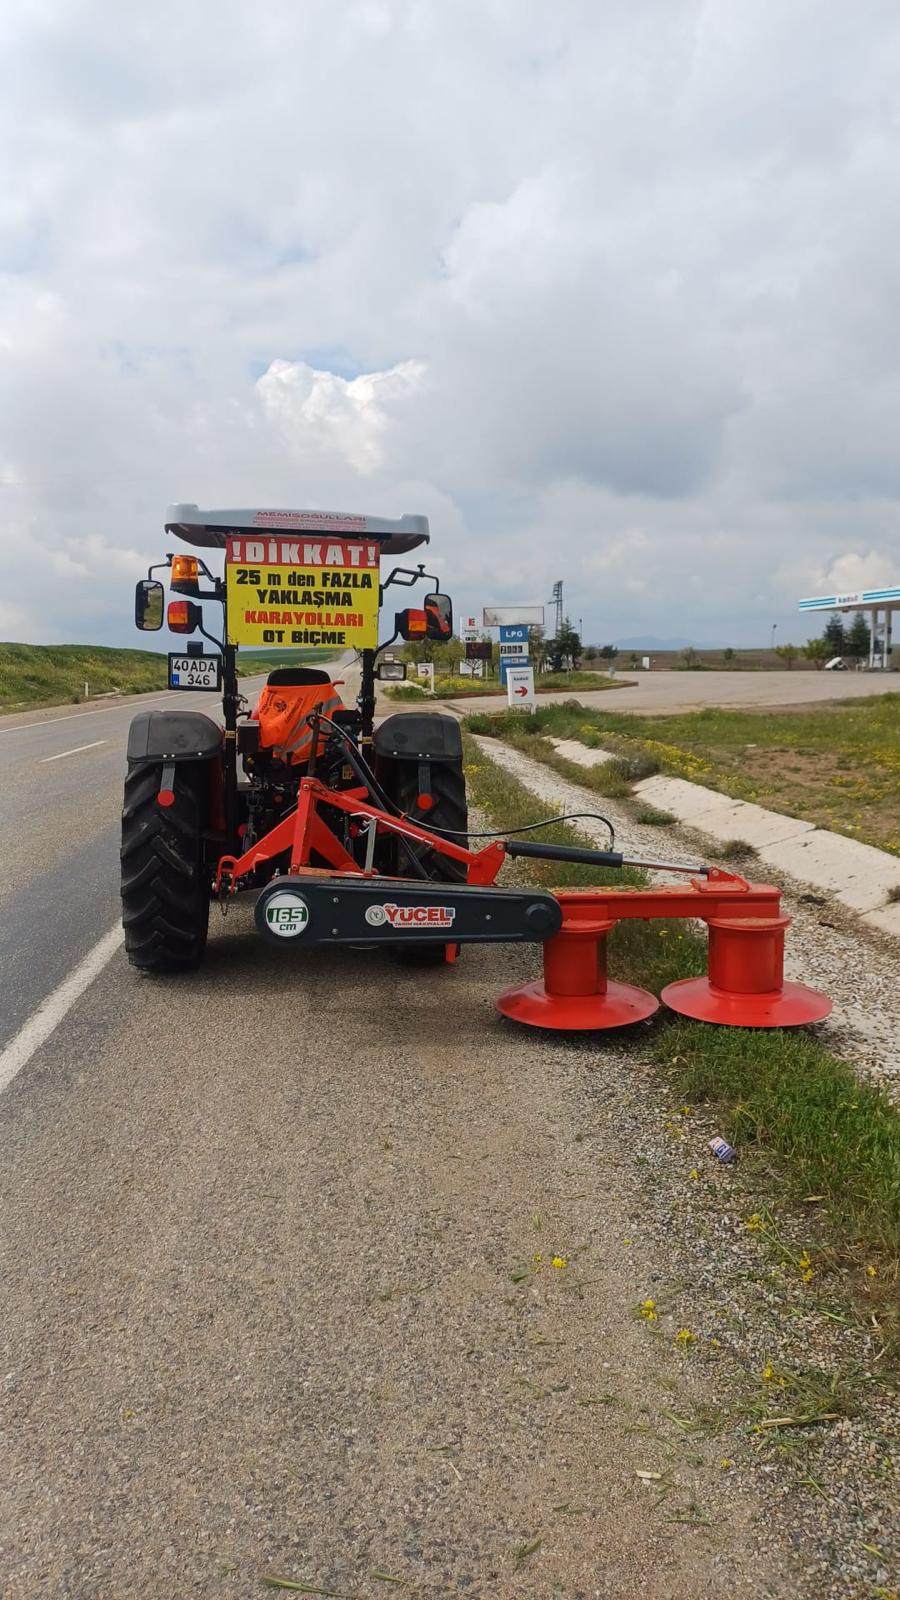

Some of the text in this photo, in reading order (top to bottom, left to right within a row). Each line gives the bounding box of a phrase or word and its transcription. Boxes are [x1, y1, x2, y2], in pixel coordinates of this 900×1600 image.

[236, 569, 372, 588] 25 m den FAZLA
[256, 589, 353, 608] YAKLAŞMA
[244, 610, 364, 627] KARAYOLLARI
[263, 628, 346, 646] OT BİÇME
[505, 630, 523, 638] LPG
[187, 674, 210, 686] 346
[271, 908, 303, 923] 165
[385, 908, 451, 922] YÜCEL
[279, 923, 297, 931] cm
